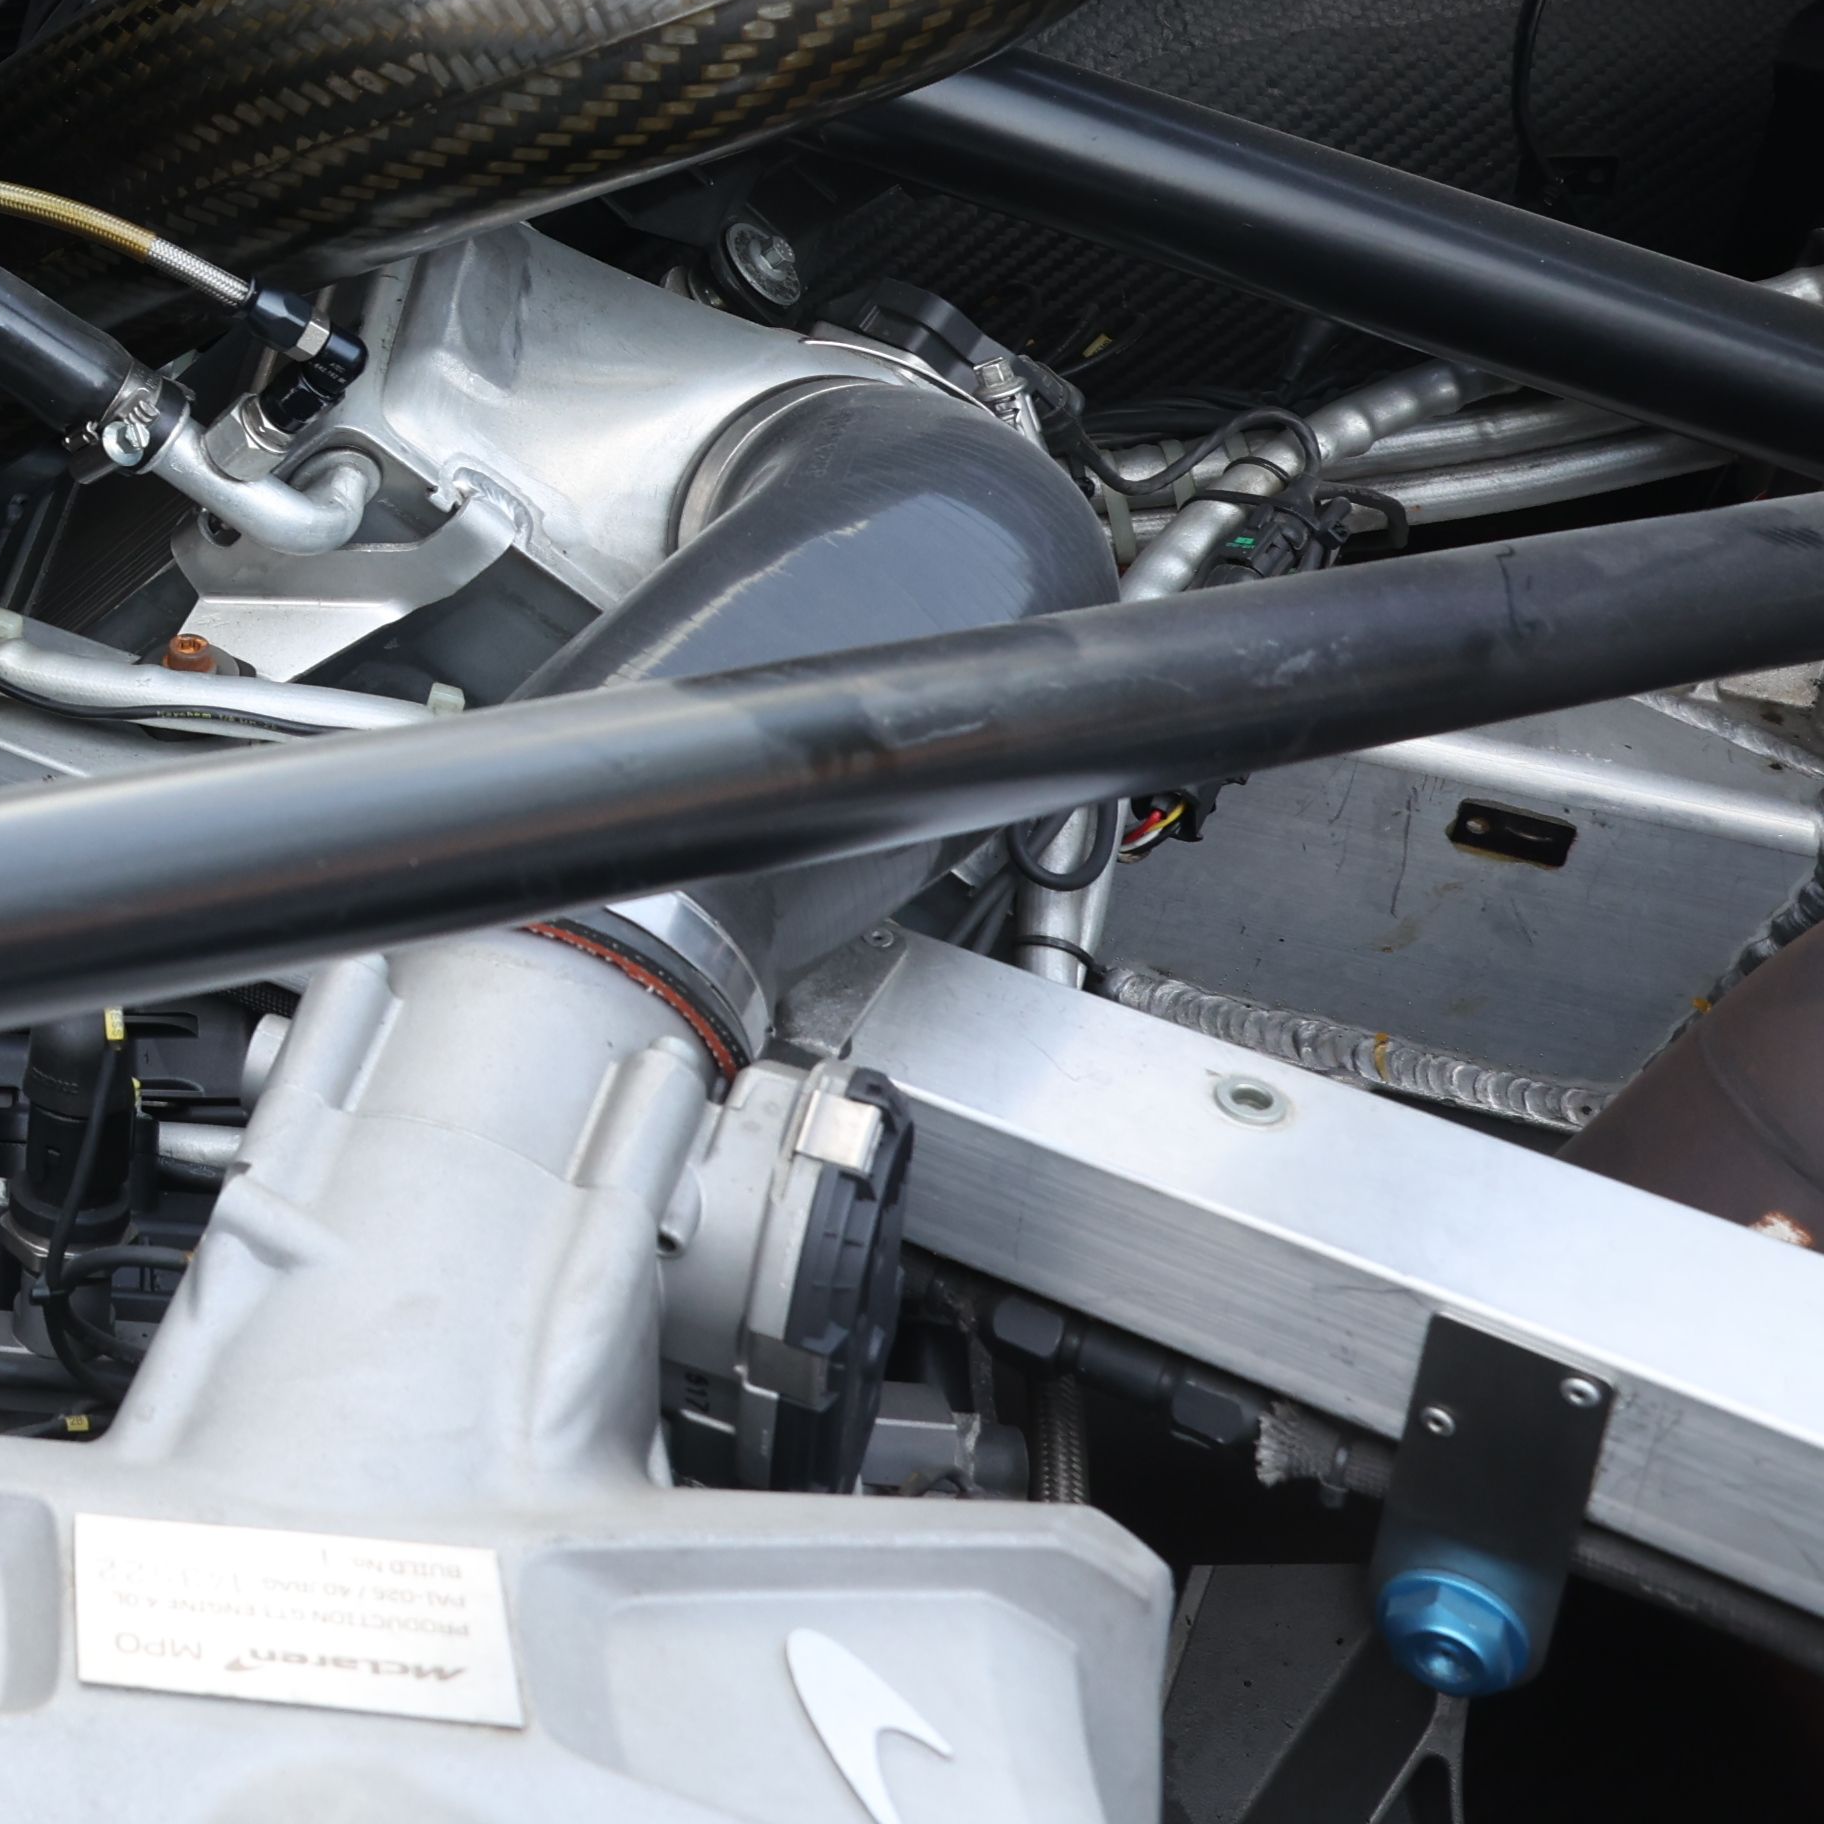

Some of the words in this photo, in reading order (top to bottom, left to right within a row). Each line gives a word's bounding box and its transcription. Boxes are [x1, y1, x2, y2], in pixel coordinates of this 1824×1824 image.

[389, 1558, 463, 1581] BUILD
[167, 1596, 256, 1616] ENGINE
[313, 1609, 471, 1639] PRODUCTION
[248, 1646, 468, 1684] McLaren
